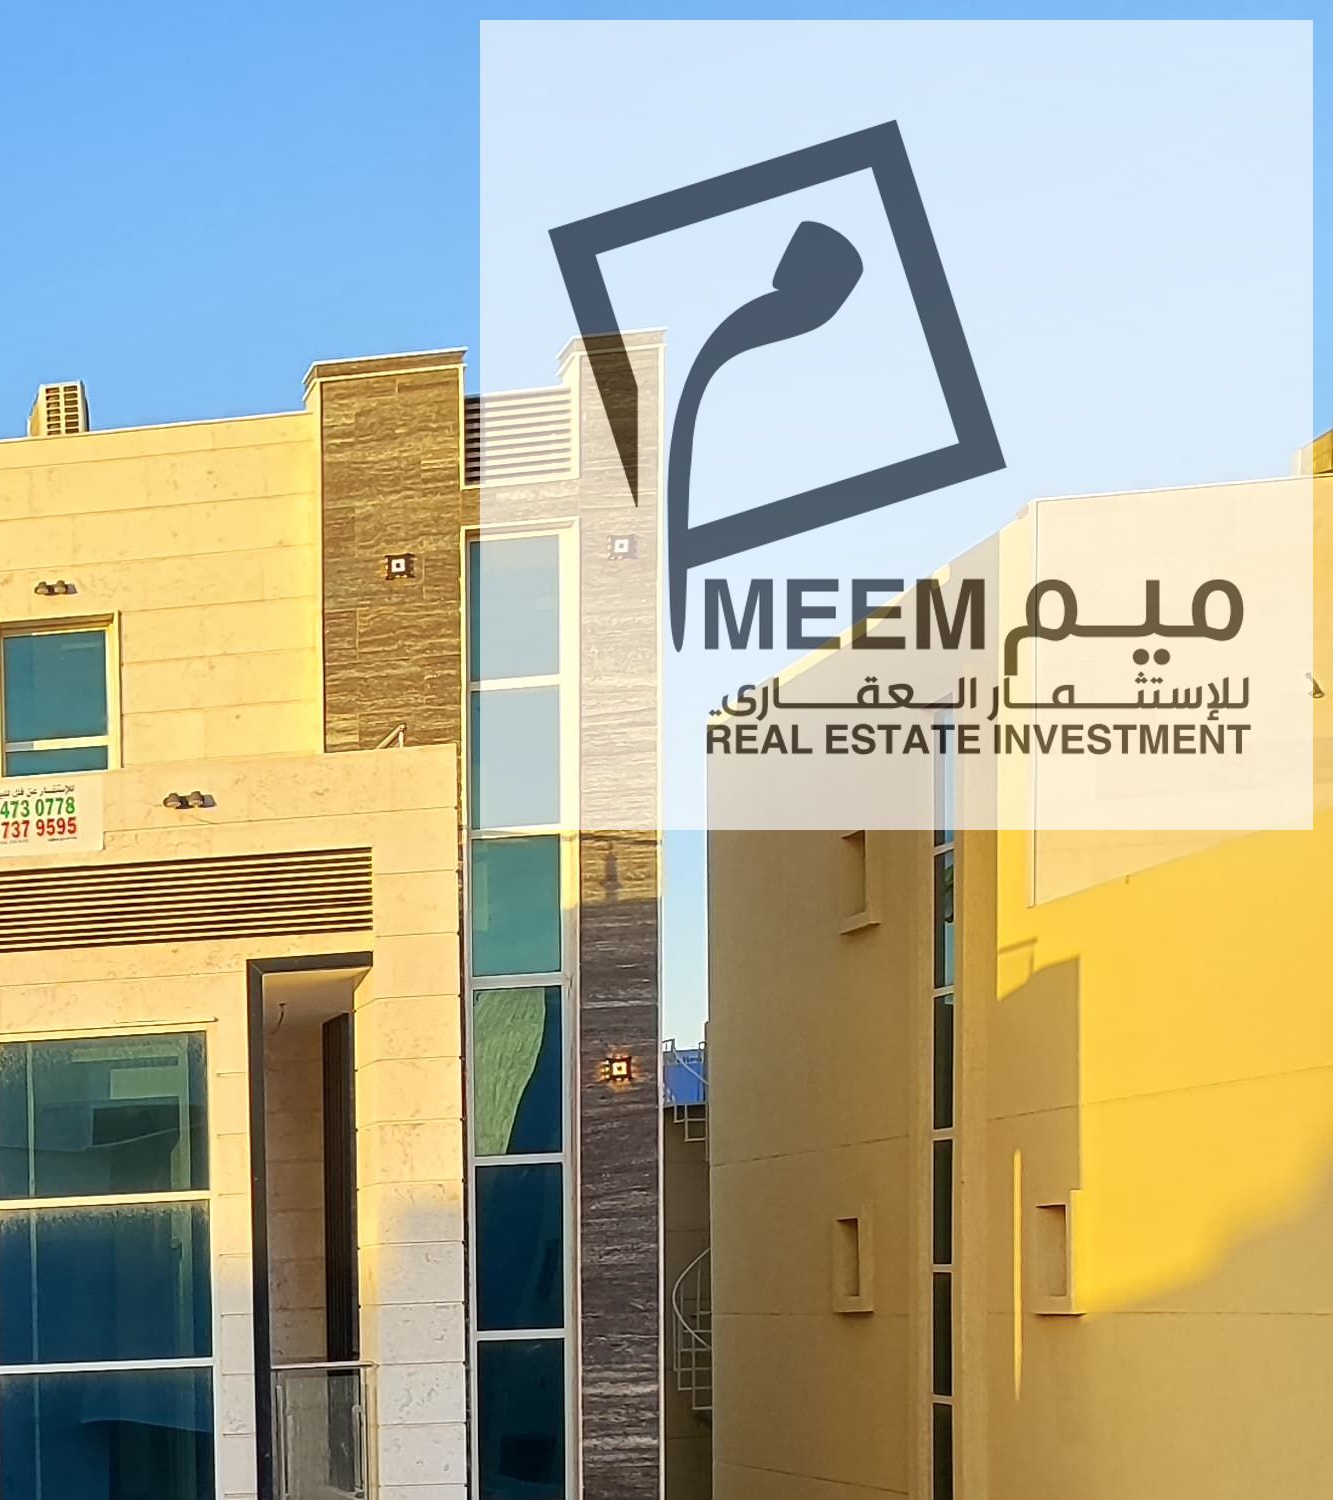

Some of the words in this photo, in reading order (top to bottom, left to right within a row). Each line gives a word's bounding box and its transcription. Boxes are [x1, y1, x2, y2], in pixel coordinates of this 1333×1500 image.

[0, 800, 30, 818] 473
[35, 796, 75, 816] 0778
[1, 820, 30, 839] 737
[35, 817, 77, 837] 9595
